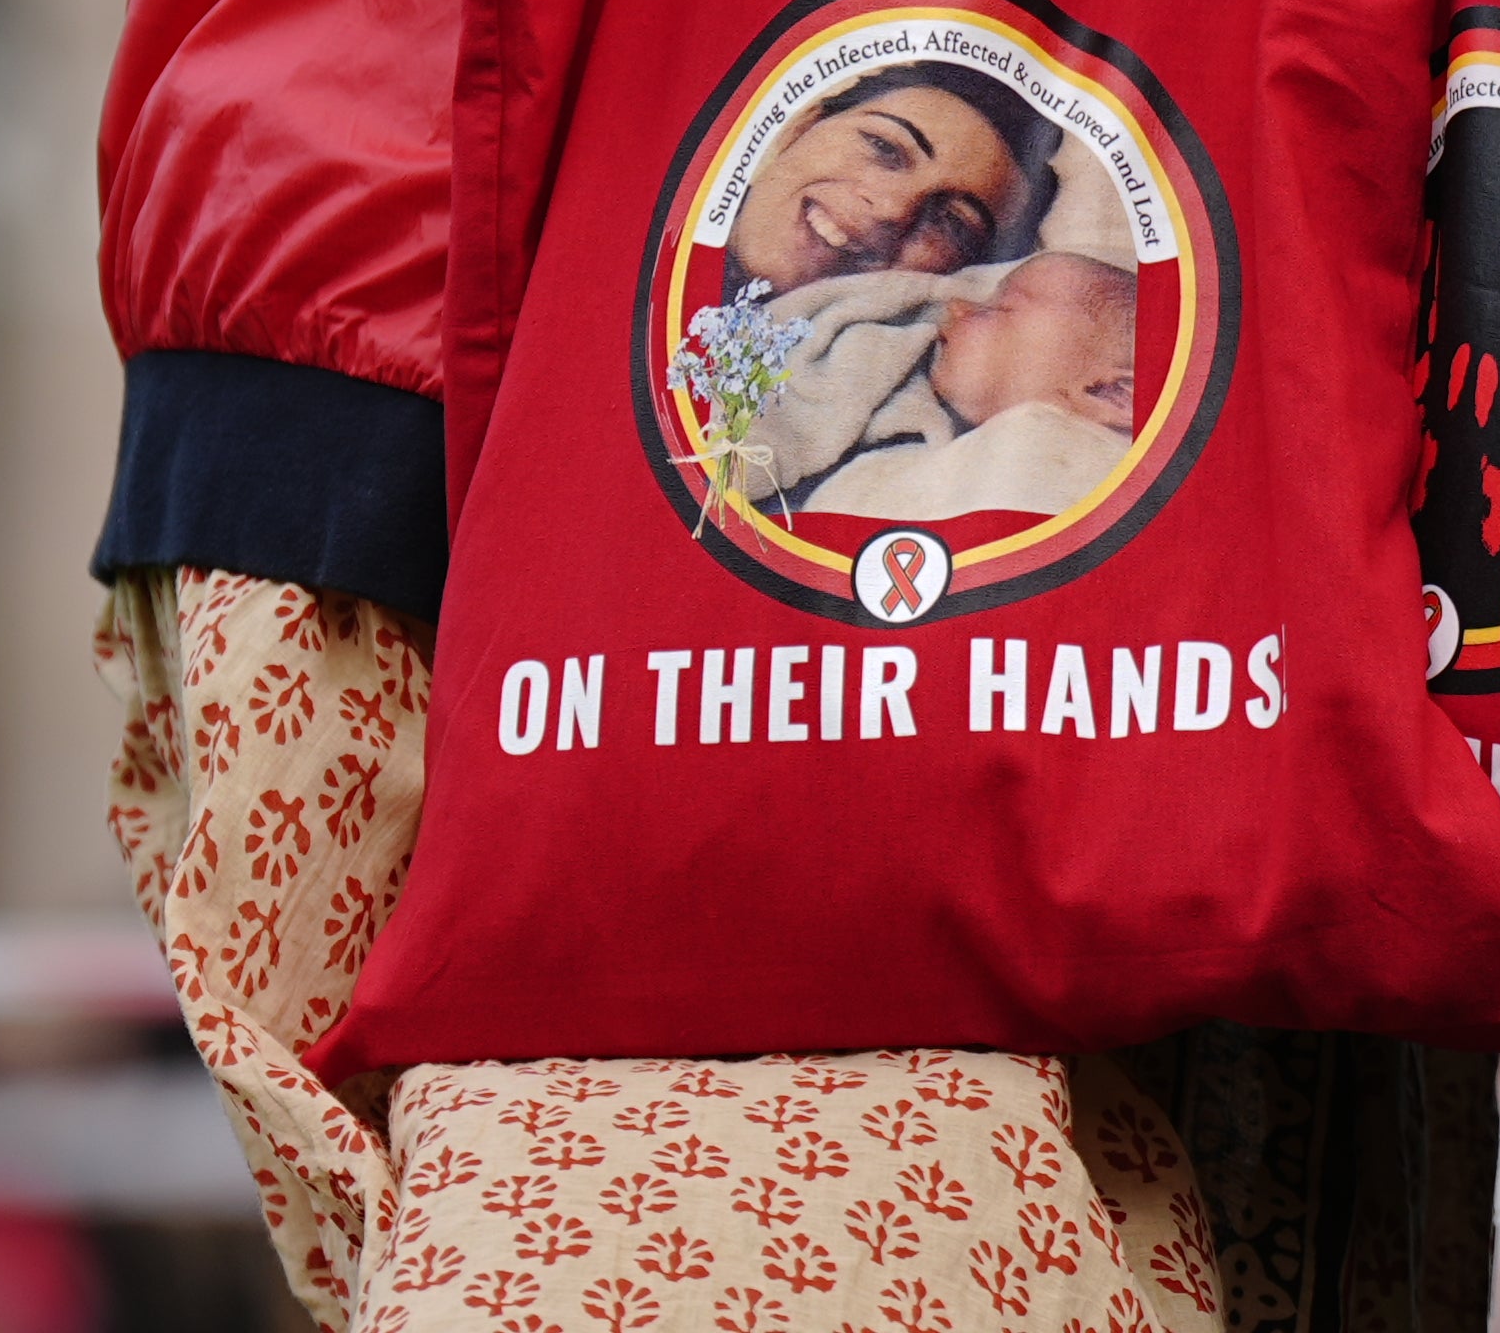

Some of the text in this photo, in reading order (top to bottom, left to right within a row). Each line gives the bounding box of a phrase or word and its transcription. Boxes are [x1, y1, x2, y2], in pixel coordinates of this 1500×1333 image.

[708, 29, 1161, 248] Supporting the Infected, Affected & our Loved and Lost
[498, 623, 1287, 756] ON THEIR HANDS
